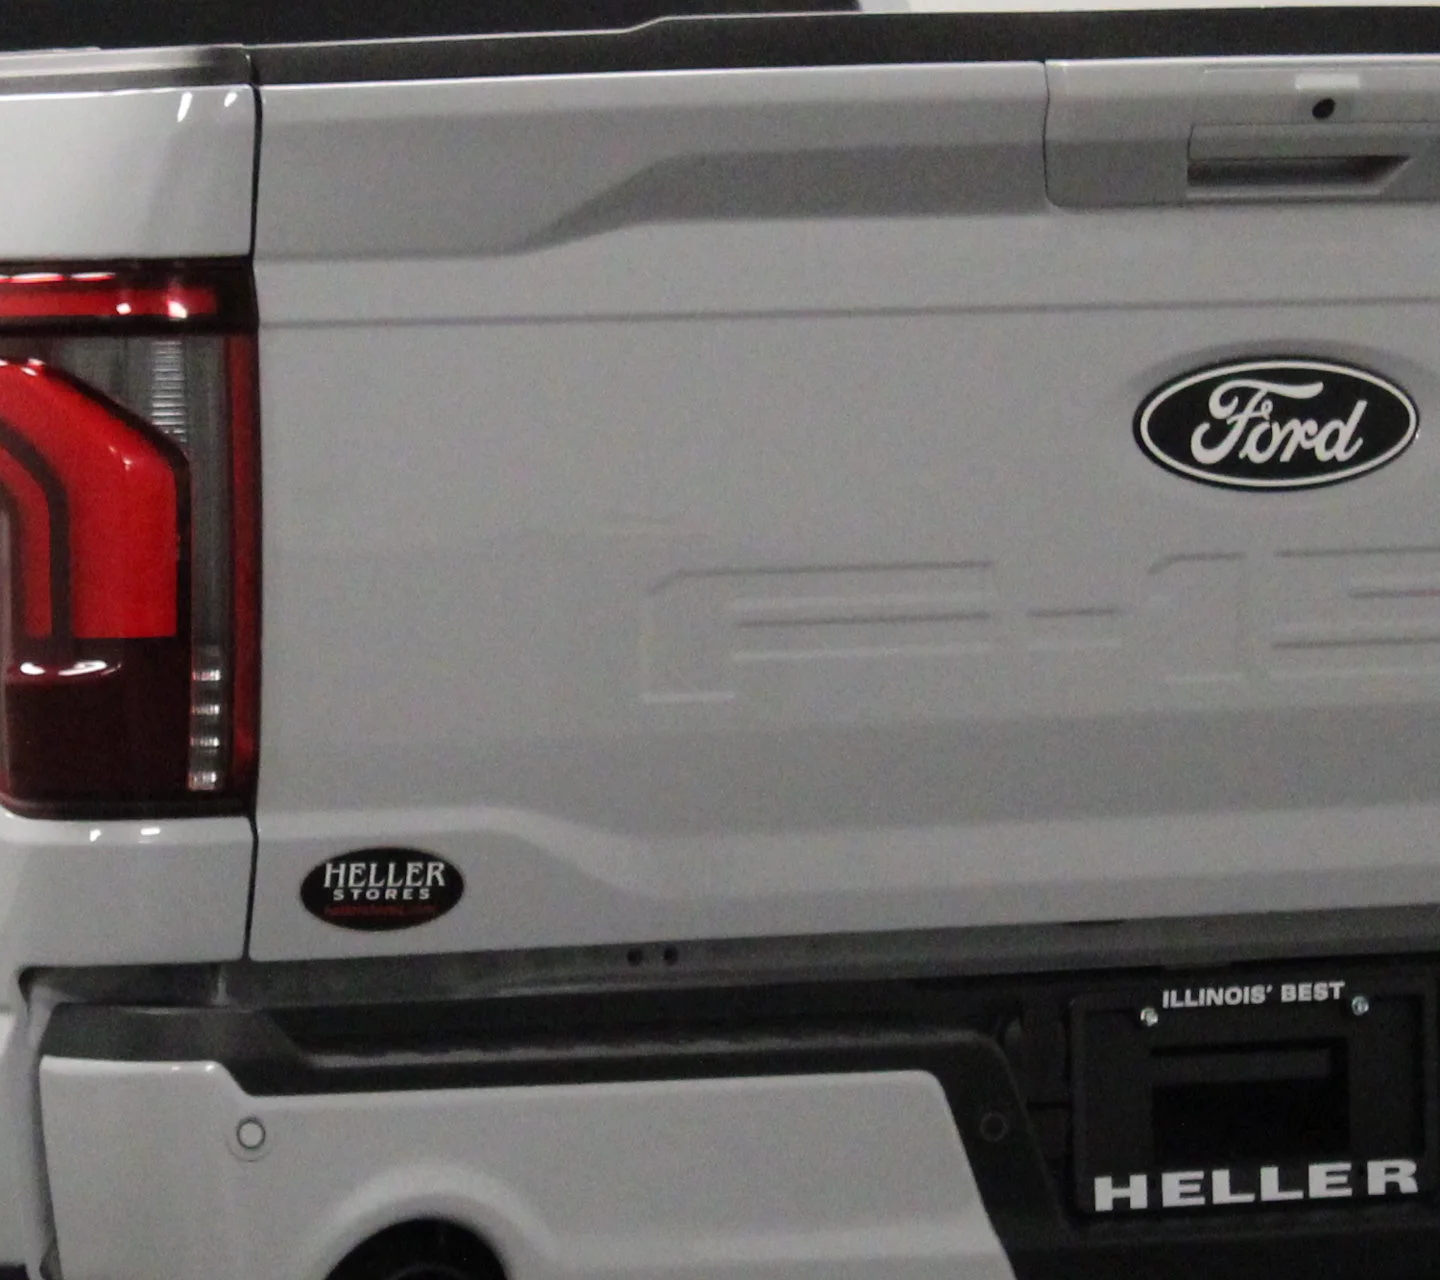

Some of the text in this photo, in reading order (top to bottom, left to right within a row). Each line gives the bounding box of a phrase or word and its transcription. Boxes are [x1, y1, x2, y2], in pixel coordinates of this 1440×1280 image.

[1190, 378, 1367, 465] Ford
[323, 860, 446, 888] HELLER
[332, 887, 431, 902] STORES
[1161, 981, 1346, 1009] ILLINOIS' BEST
[1093, 1158, 1419, 1212] HELLER
